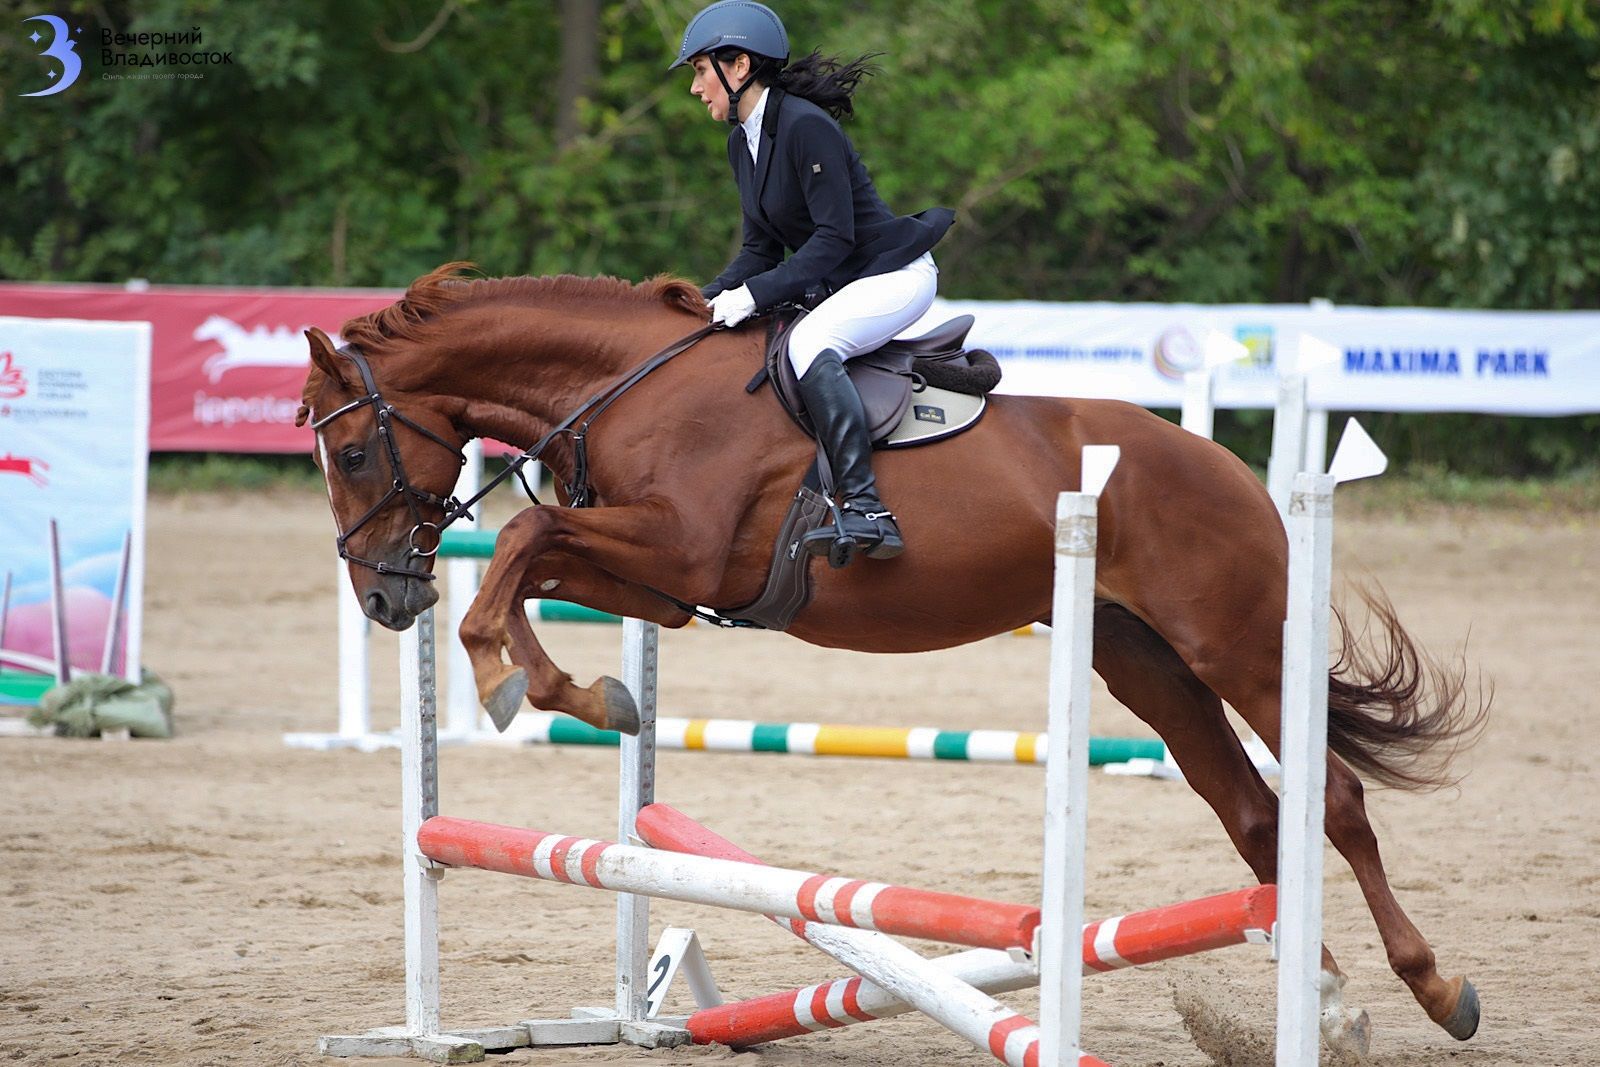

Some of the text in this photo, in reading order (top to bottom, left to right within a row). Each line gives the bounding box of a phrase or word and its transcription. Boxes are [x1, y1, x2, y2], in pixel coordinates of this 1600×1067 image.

[1344, 349, 1549, 376] MAXIMA PARK
[647, 954, 671, 1014] 2
